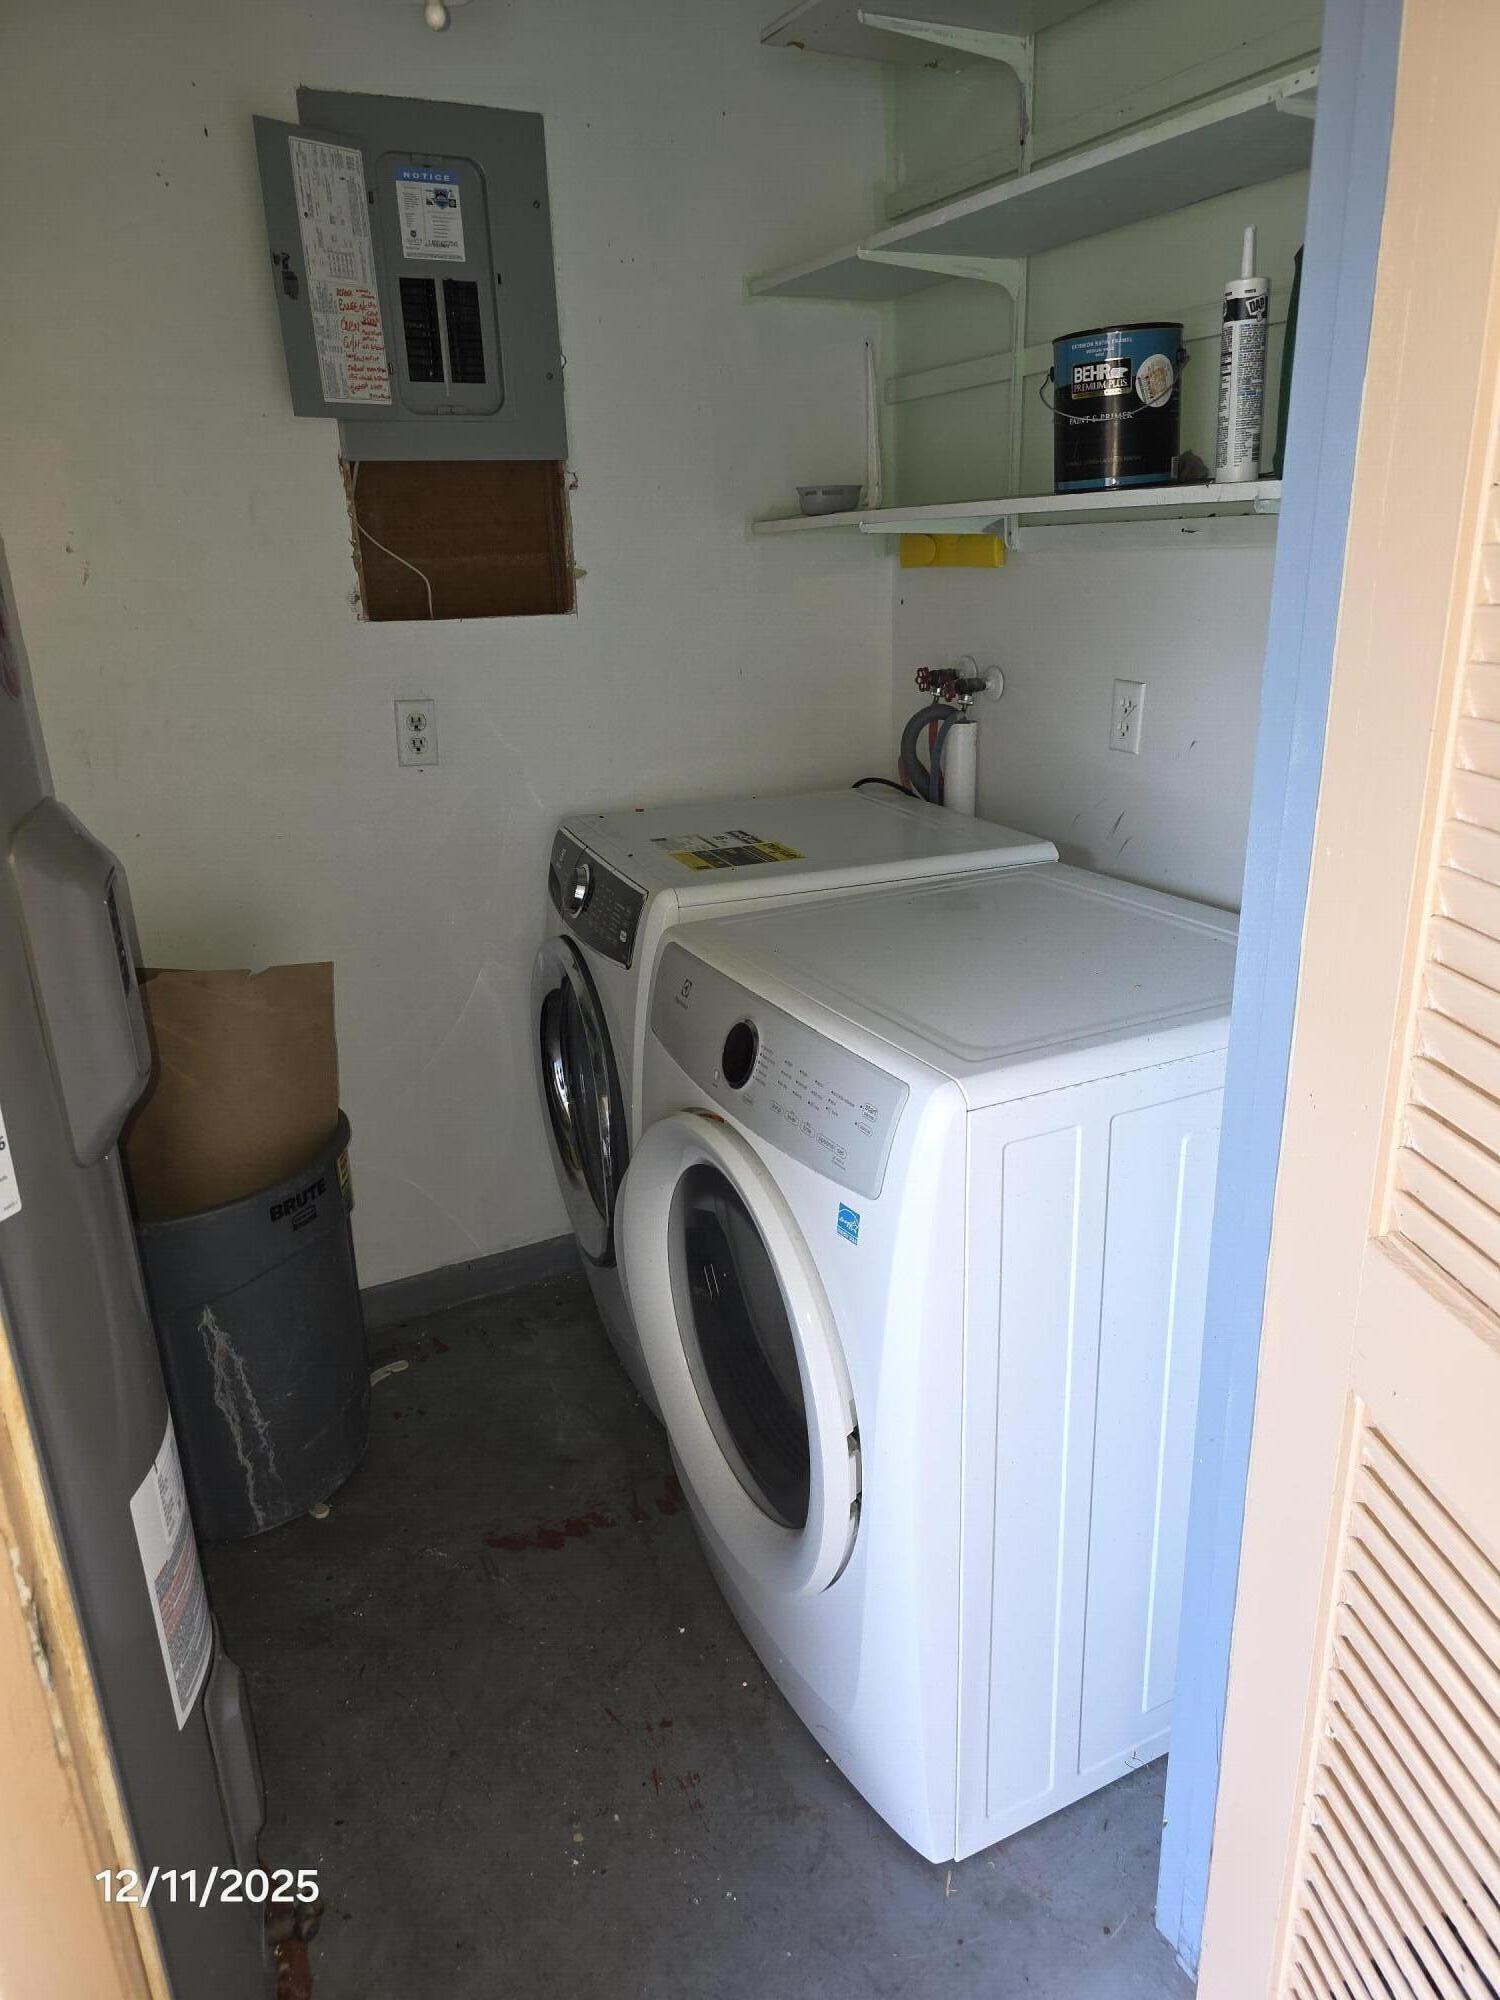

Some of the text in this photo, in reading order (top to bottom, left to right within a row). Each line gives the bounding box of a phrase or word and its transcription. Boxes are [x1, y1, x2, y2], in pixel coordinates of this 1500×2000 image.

[403, 171, 451, 181] NOTICE
[1248, 297, 1265, 313] DAP
[1074, 363, 1111, 383] BEHR
[1073, 381, 1107, 393] PREMIUM
[1108, 378, 1128, 389] PLUS
[269, 1177, 327, 1222] BRUTE
